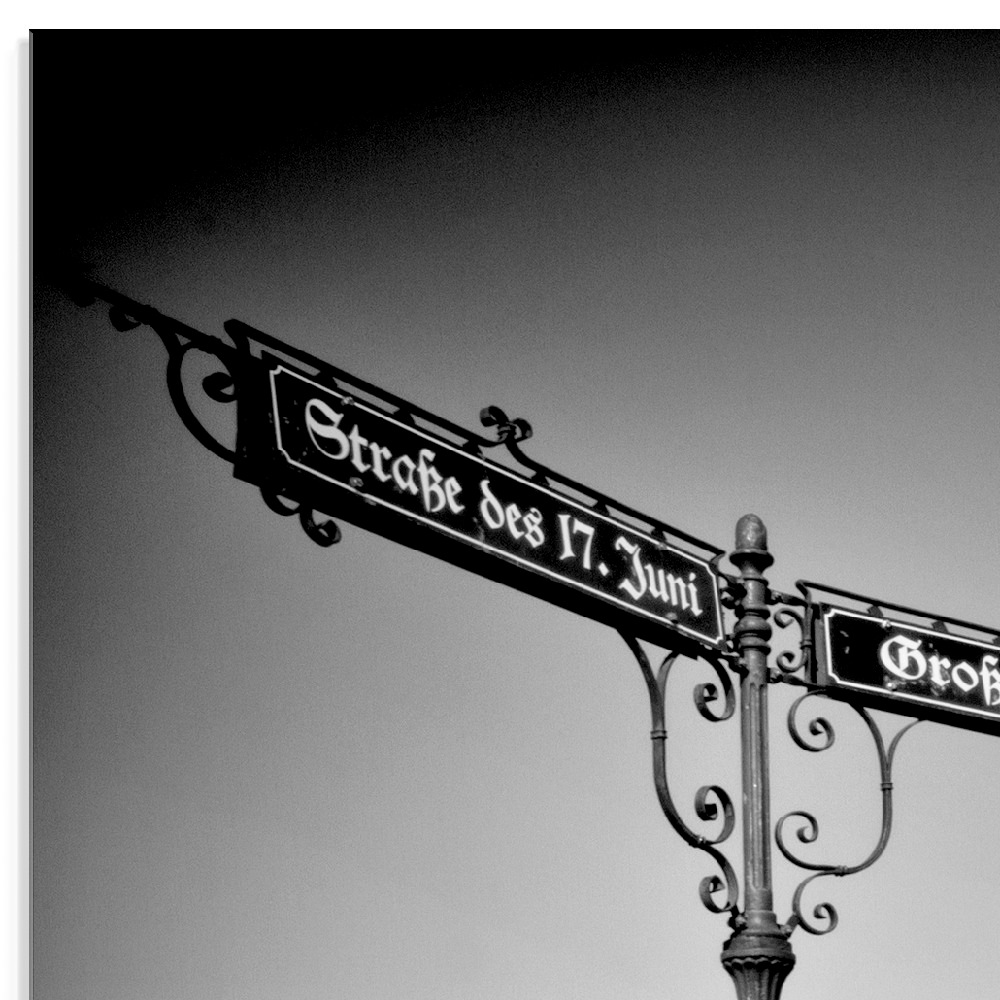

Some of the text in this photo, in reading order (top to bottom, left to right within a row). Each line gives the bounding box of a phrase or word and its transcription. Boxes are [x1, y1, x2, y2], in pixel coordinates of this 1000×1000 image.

[305, 398, 703, 616] Straße des 17. Juni
